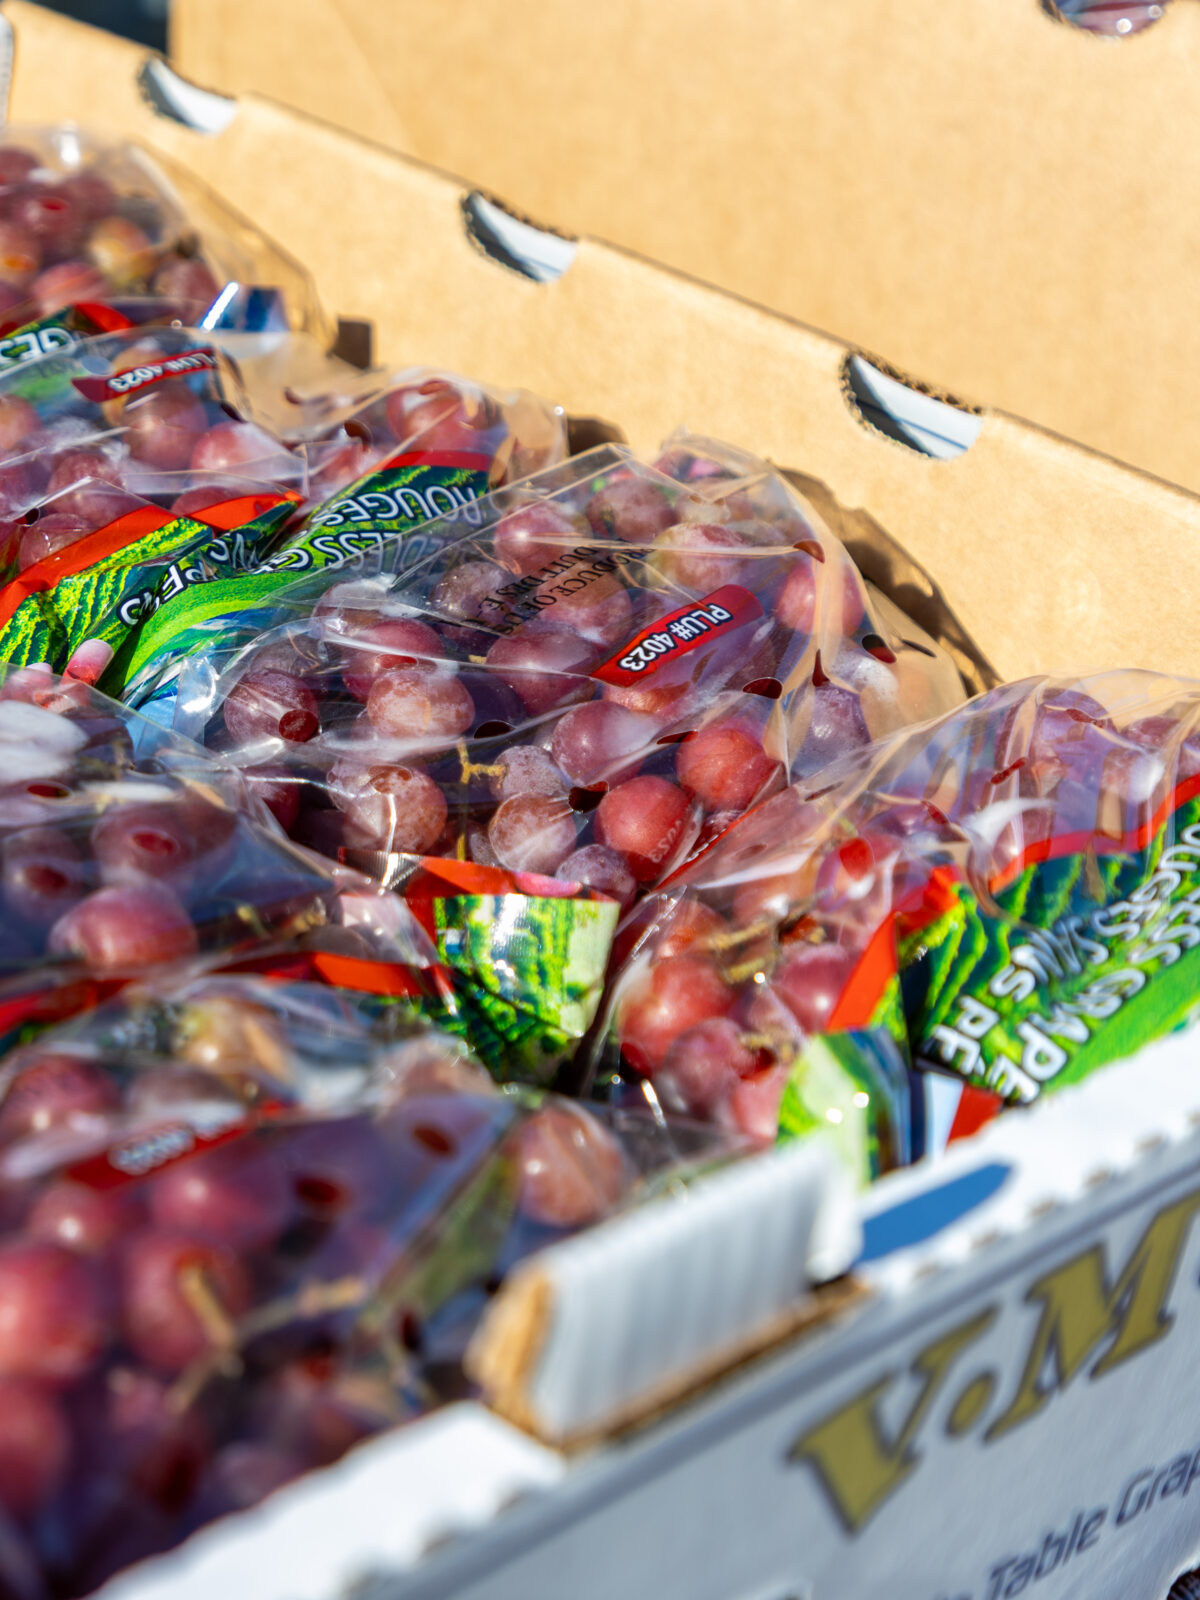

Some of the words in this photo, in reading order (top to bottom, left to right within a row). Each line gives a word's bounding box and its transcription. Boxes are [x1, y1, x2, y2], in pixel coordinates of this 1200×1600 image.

[107, 365, 164, 393] 4023
[312, 484, 483, 527] ROUGES
[669, 604, 732, 641] PLU#
[617, 631, 675, 673] 4023
[985, 1504, 1110, 1600] Table
